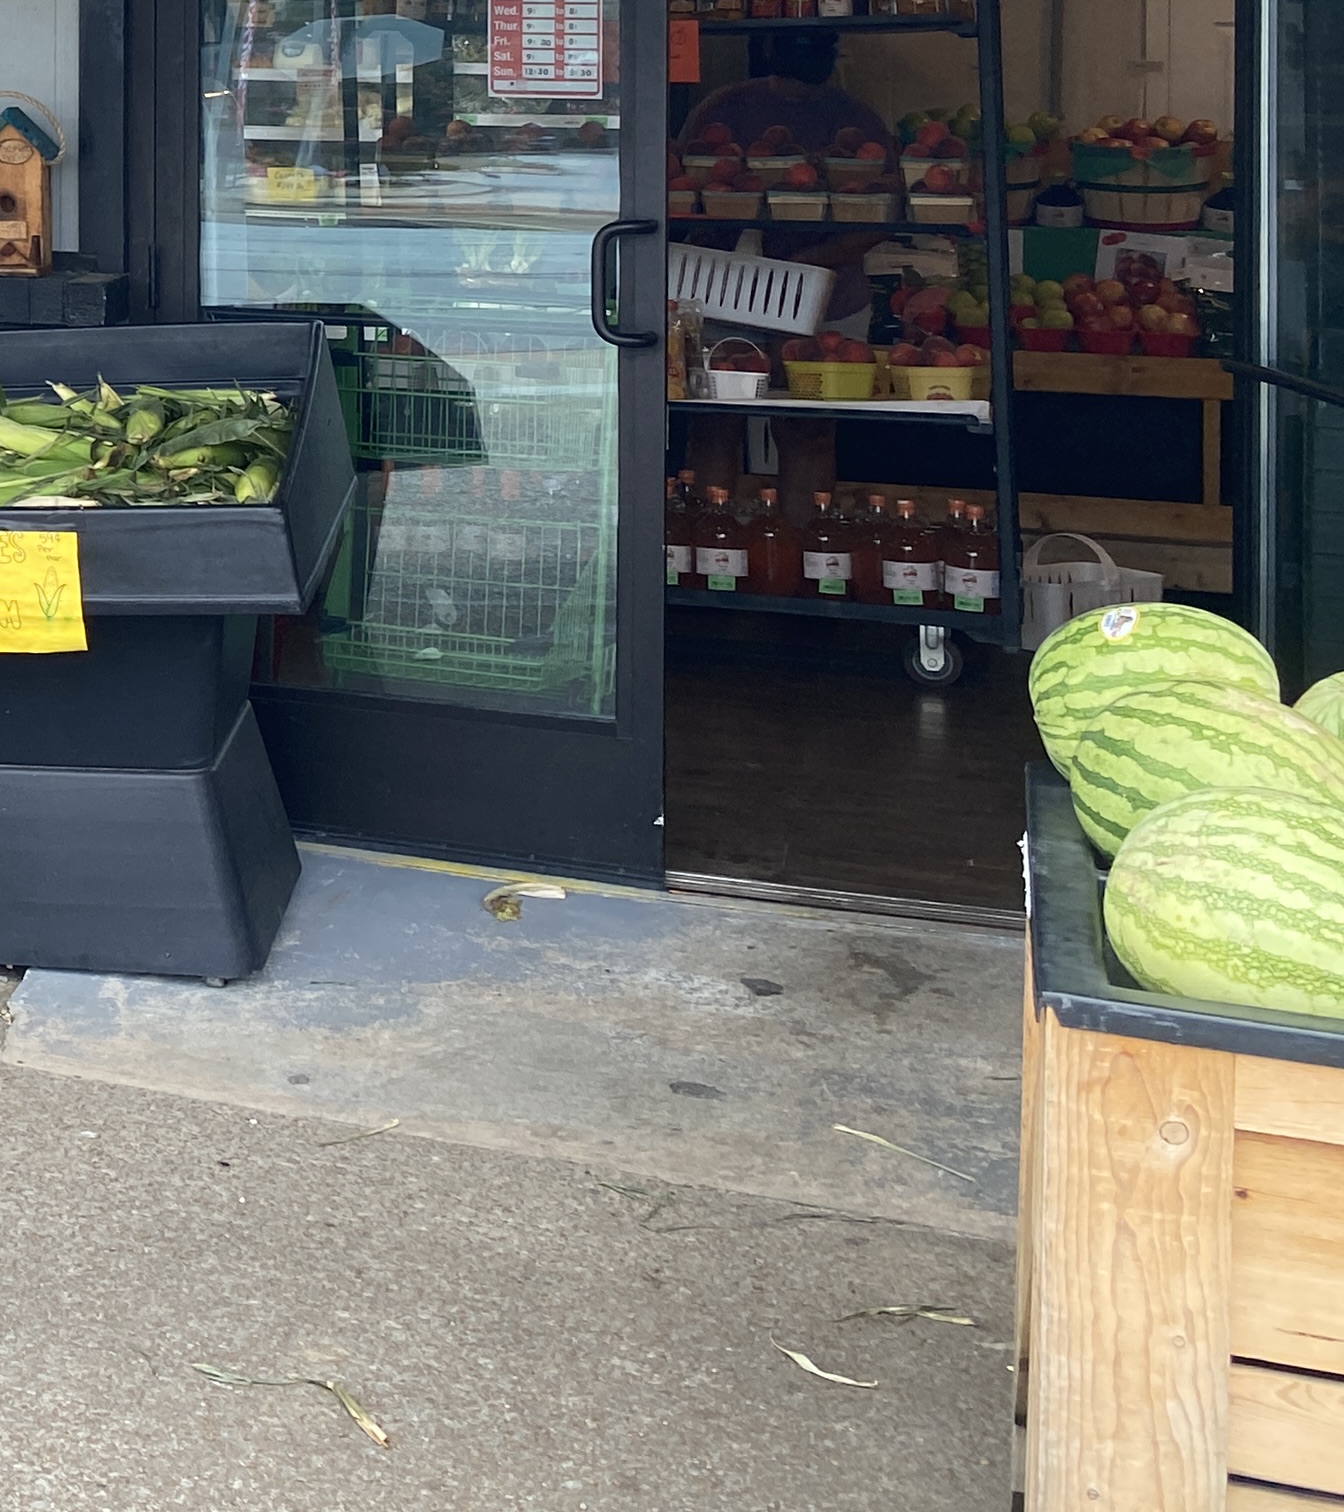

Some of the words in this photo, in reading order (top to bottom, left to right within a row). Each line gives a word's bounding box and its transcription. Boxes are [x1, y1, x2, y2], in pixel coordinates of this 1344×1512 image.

[494, 6, 520, 15] Wed.
[494, 21, 521, 31] Thur.
[494, 36, 510, 45] Fri.
[494, 51, 514, 61] Sat.
[494, 67, 516, 77] Sun.
